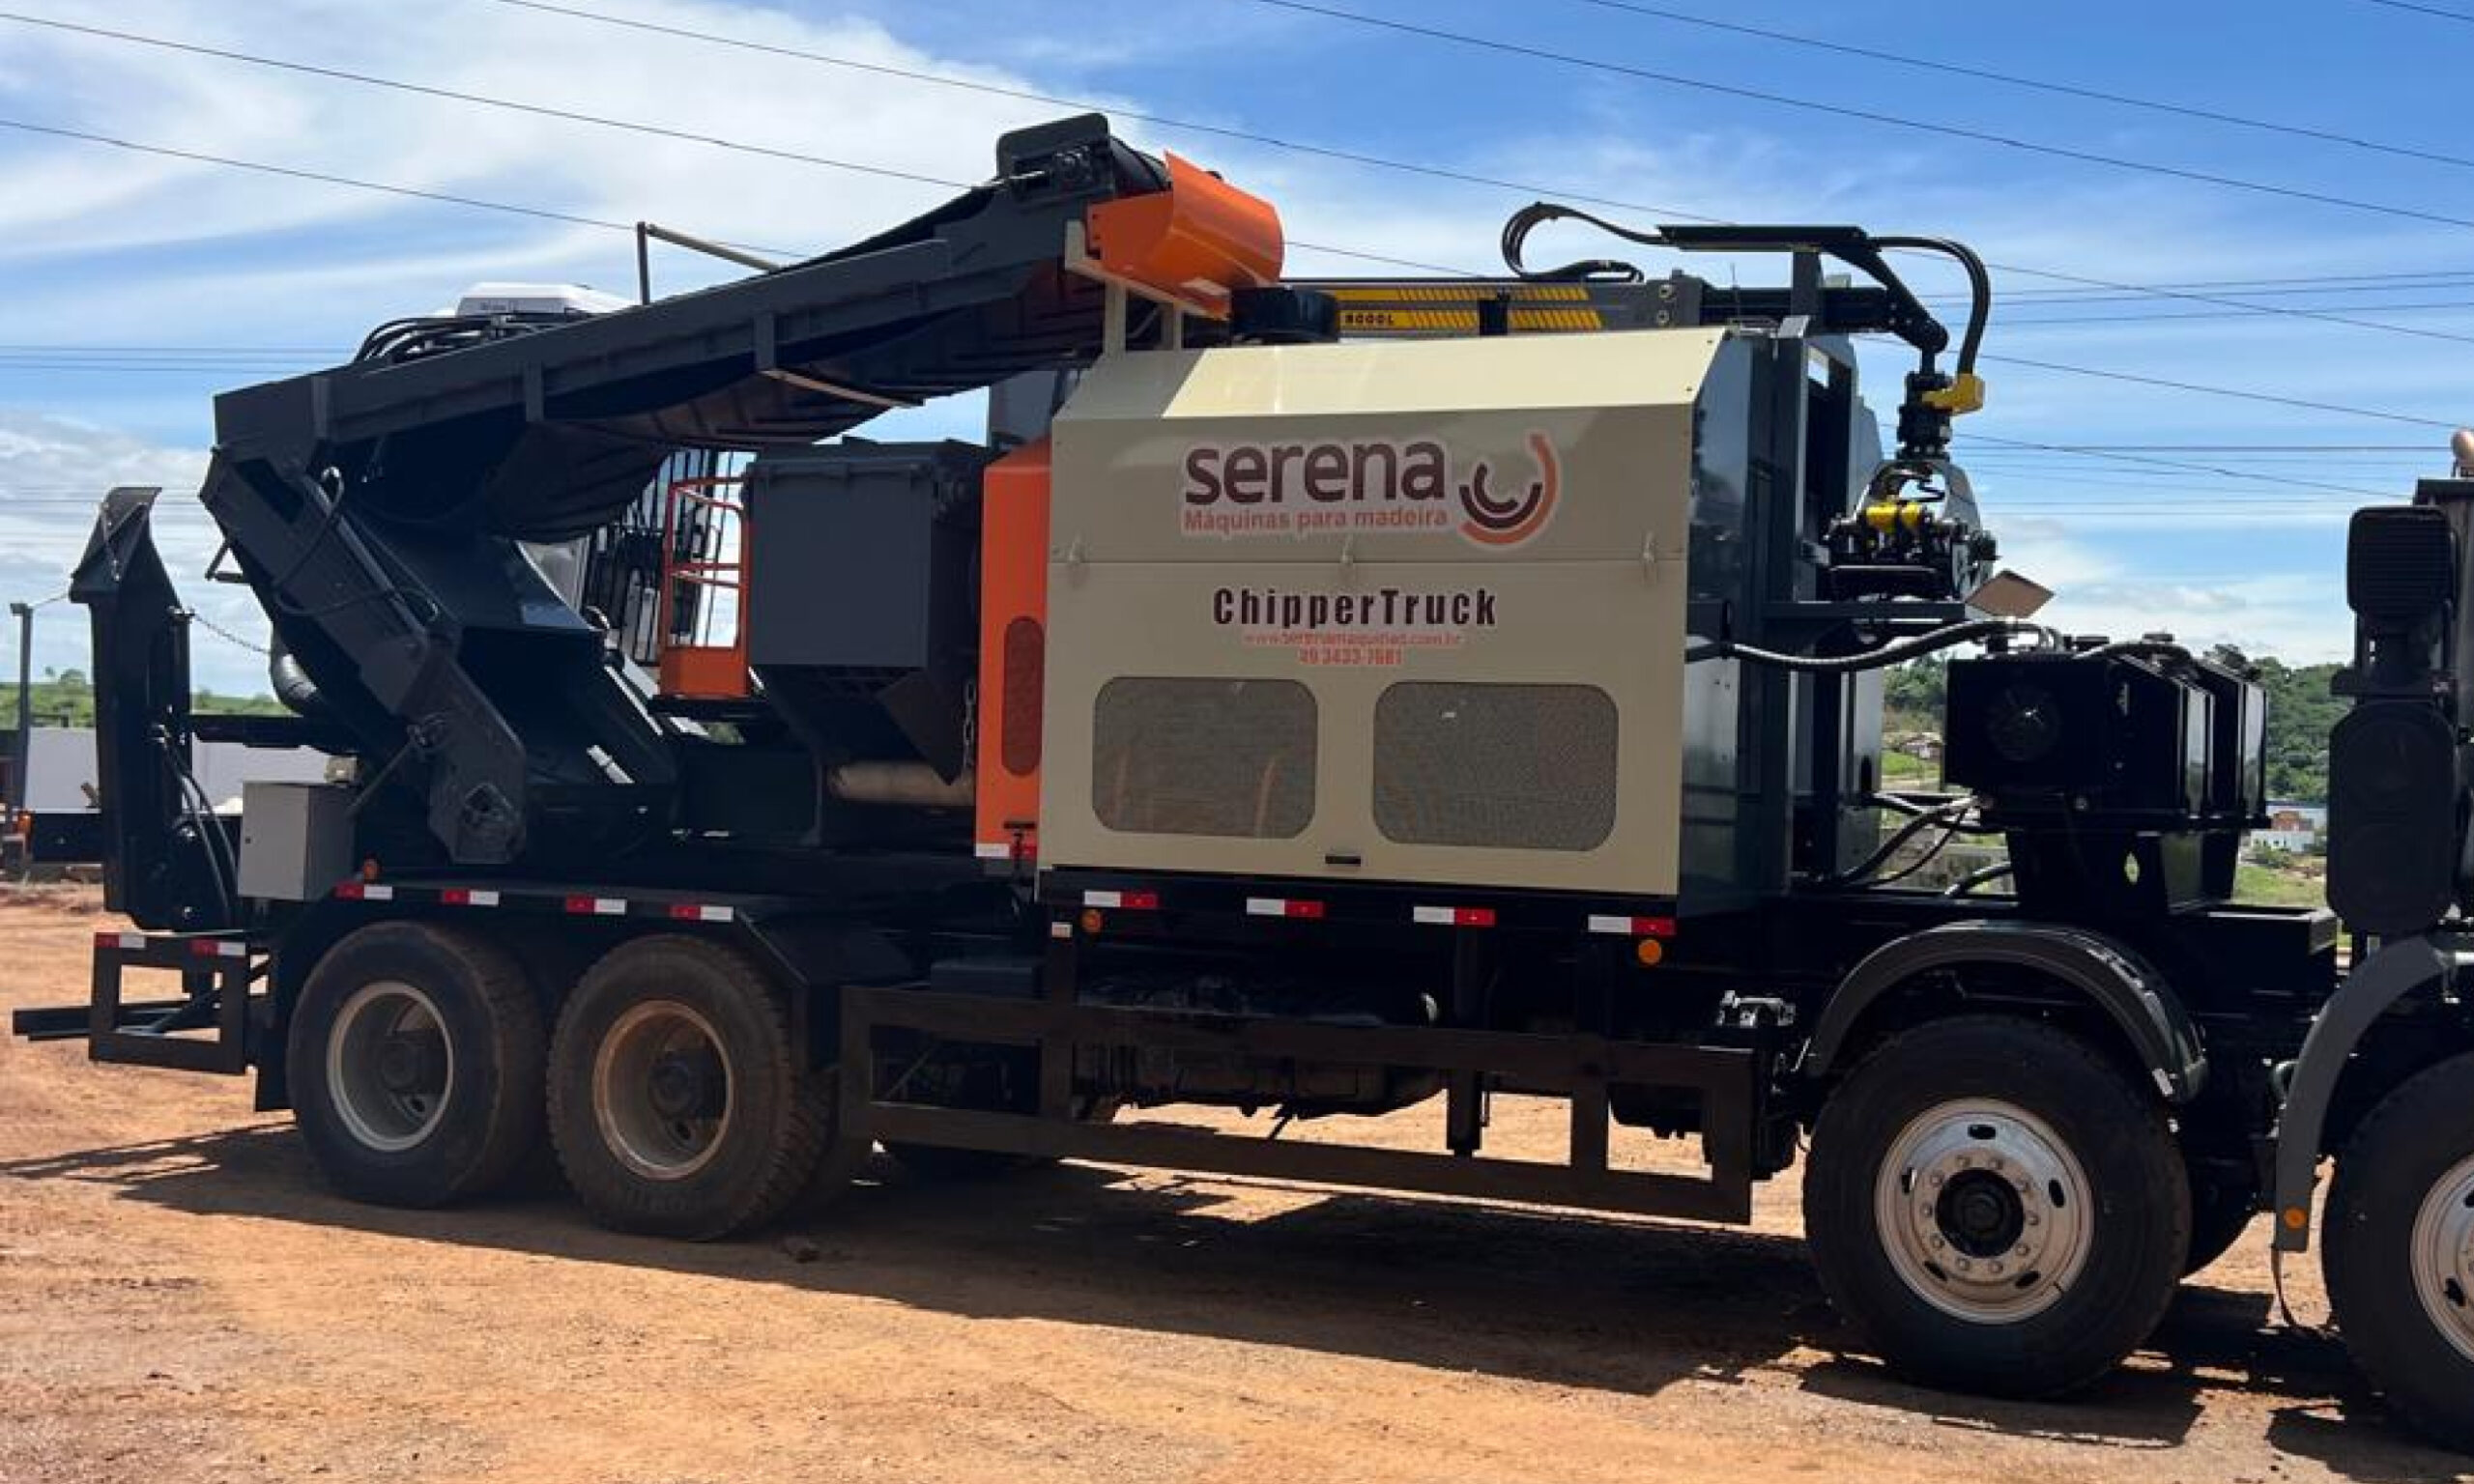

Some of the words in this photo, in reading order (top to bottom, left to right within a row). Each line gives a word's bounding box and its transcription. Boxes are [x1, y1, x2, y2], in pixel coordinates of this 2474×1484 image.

[1185, 442, 1445, 505] serena
[1184, 509, 1290, 534] Máquinas
[1297, 510, 1346, 530] para
[1355, 505, 1448, 528] madeira
[1213, 587, 1496, 629] ChipperTruck
